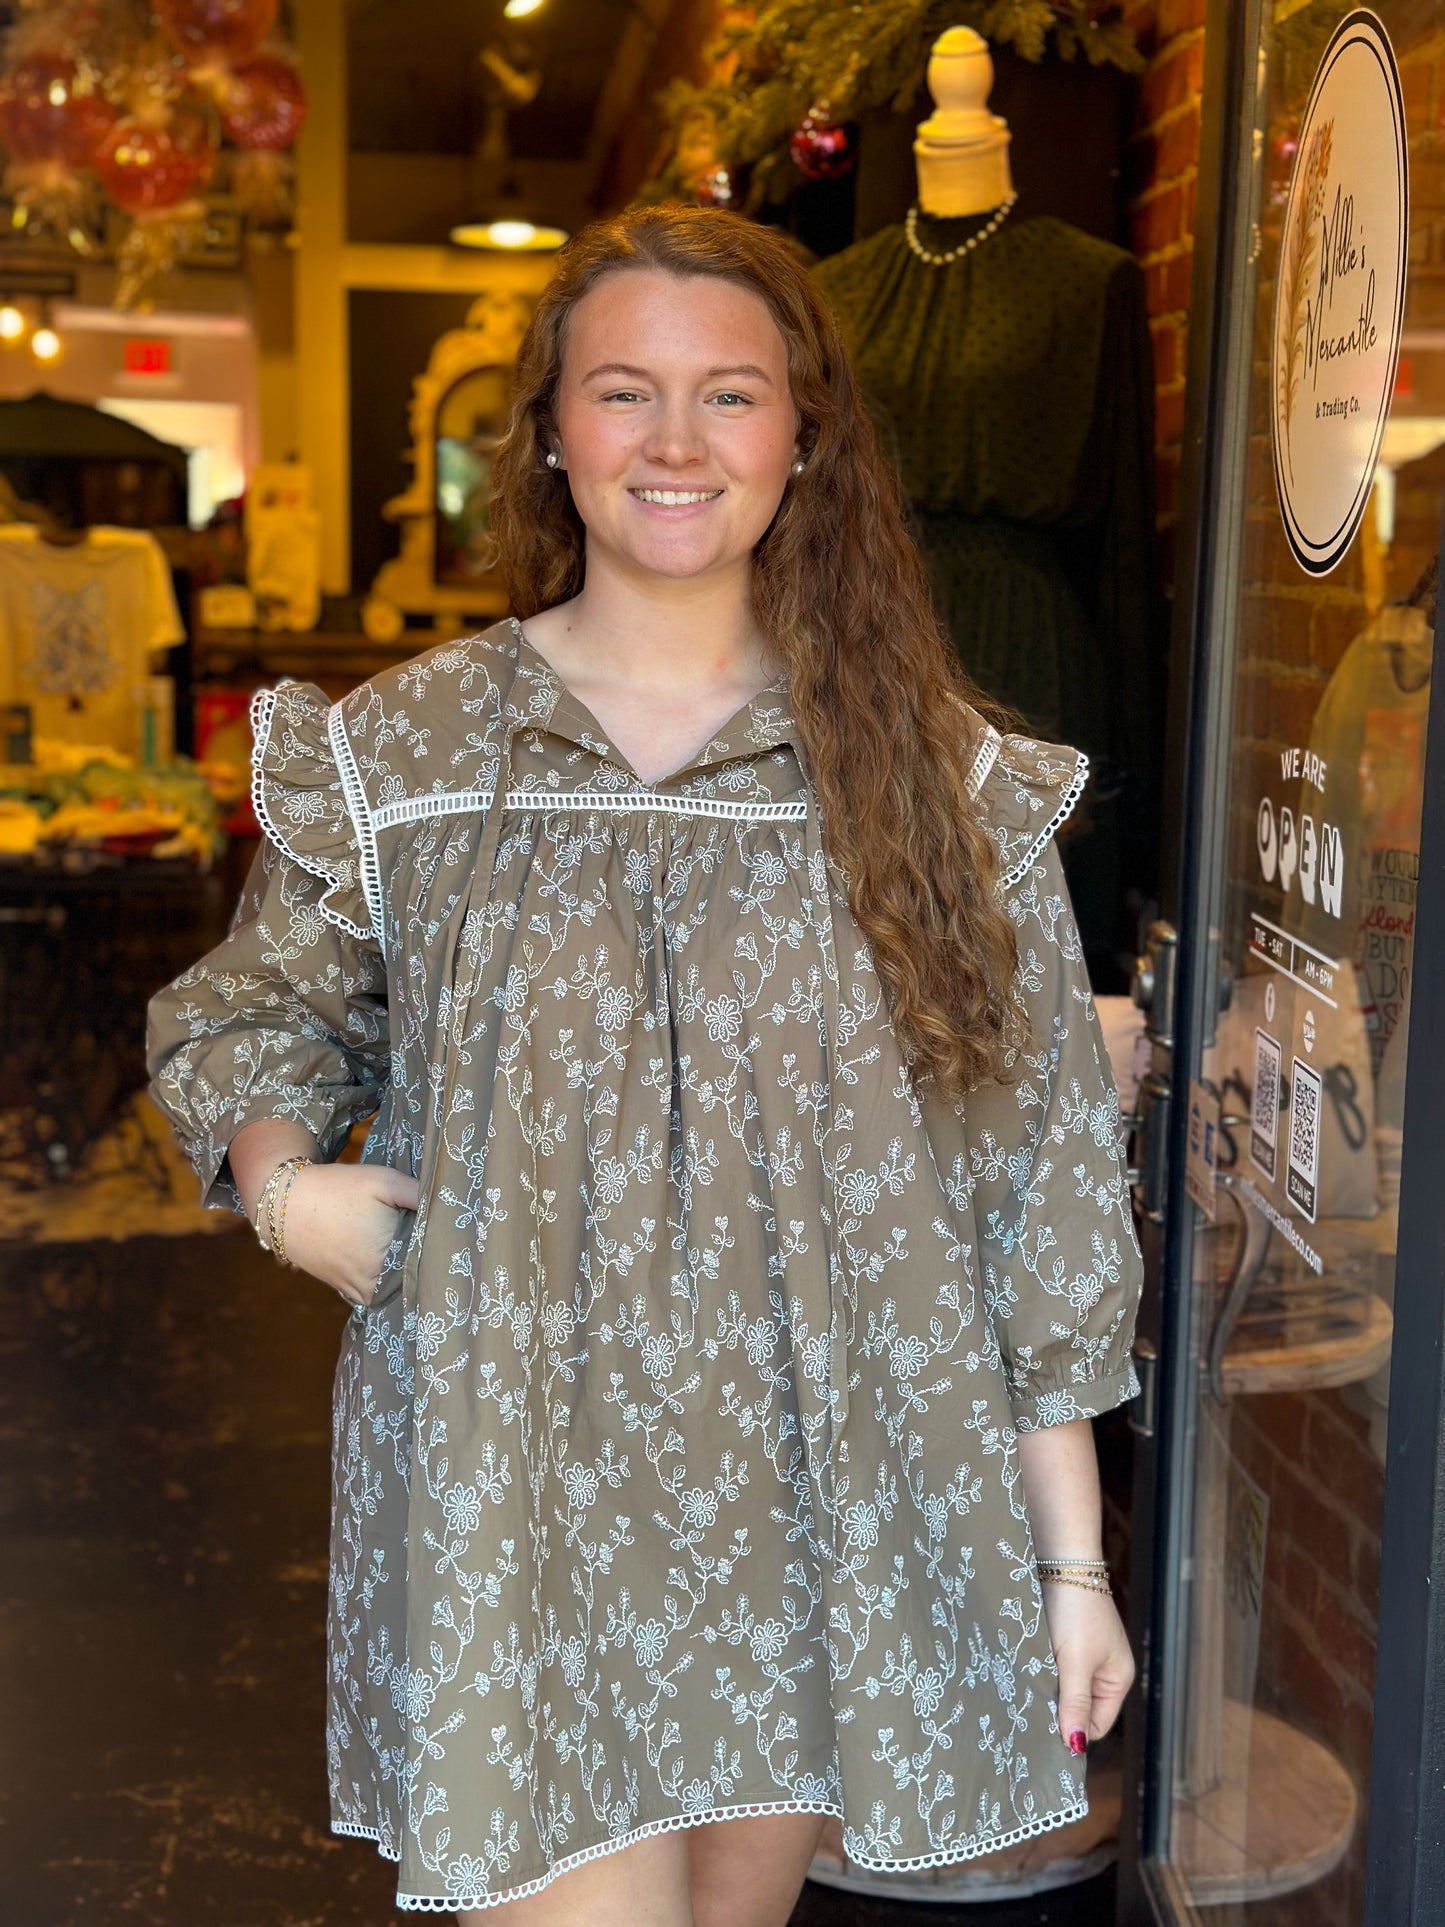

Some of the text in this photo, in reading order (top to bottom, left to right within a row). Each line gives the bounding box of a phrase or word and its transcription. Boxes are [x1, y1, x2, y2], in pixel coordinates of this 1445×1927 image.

[1320, 184, 1366, 309] Millie's
[1303, 268, 1377, 392] Mercantile
[1315, 396, 1360, 419] & Trading Co.
[1281, 748, 1327, 793] WE ARE
[1257, 797, 1344, 920] OPEN
[1290, 1175, 1313, 1208] SCAN ME
